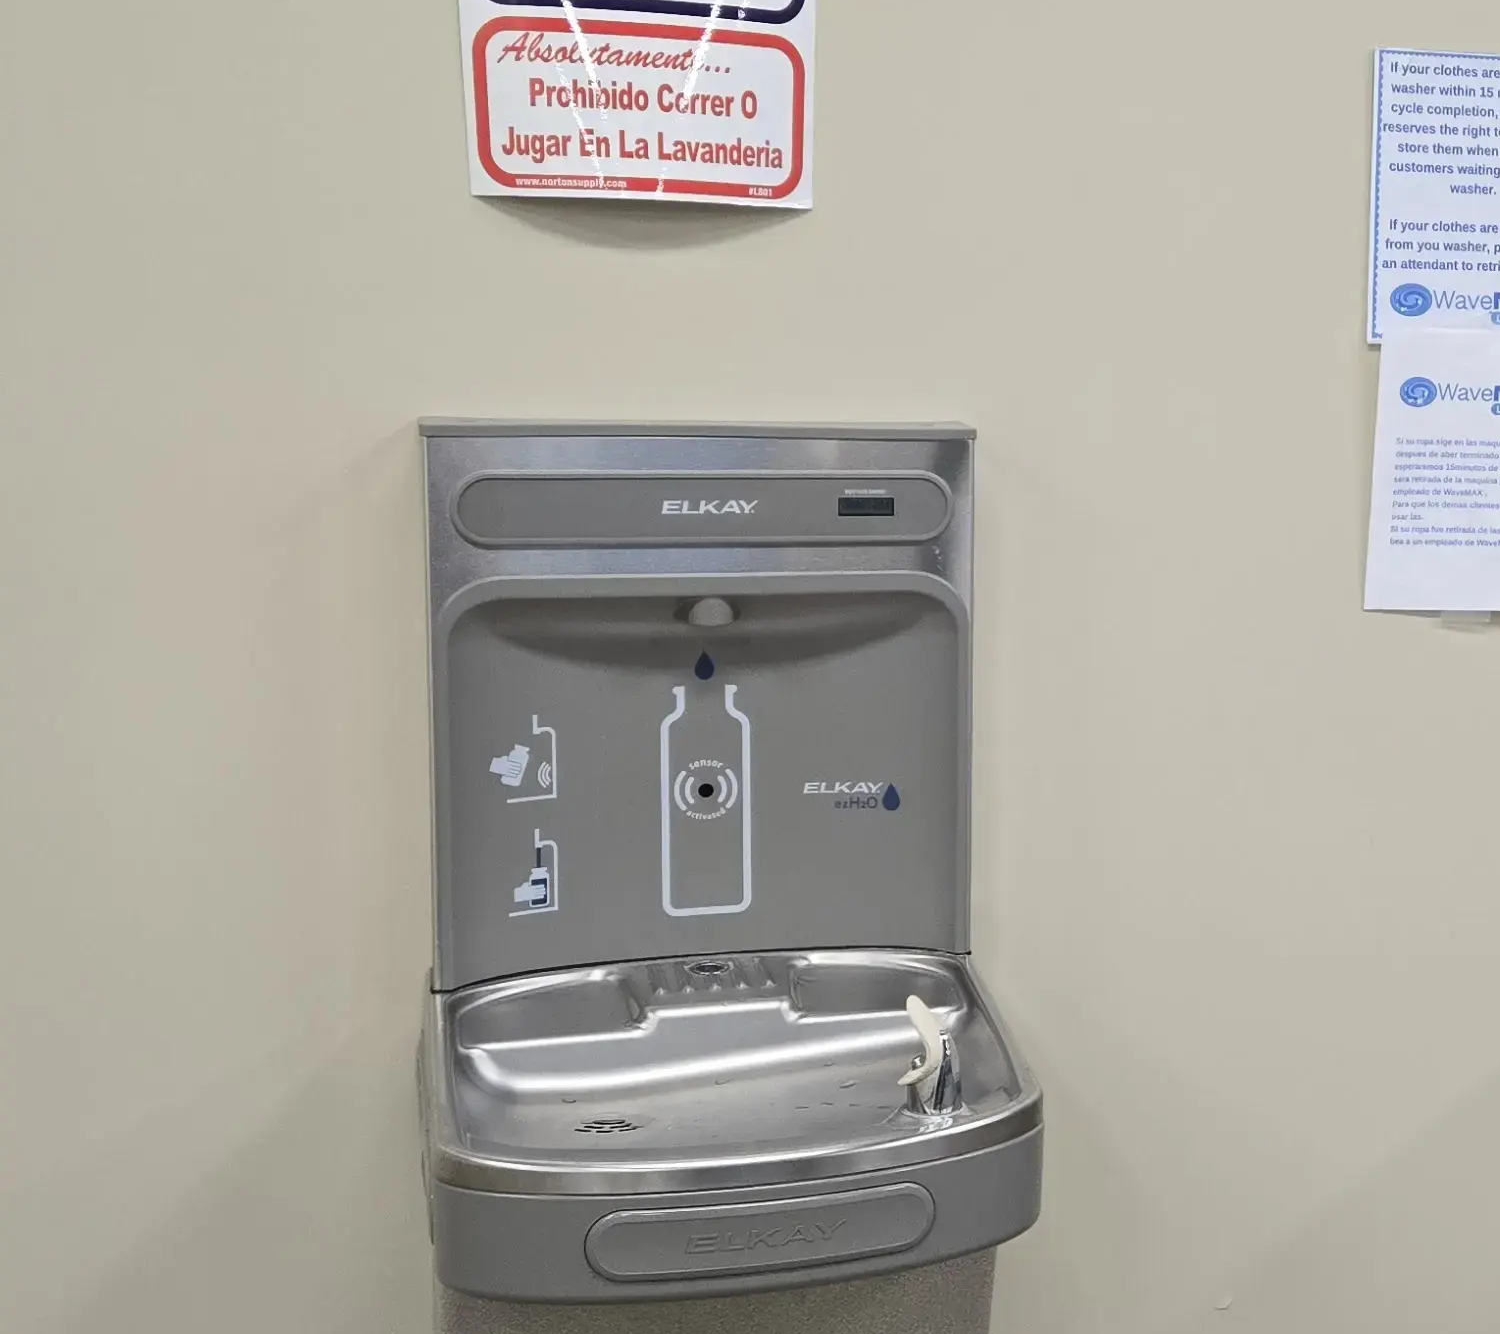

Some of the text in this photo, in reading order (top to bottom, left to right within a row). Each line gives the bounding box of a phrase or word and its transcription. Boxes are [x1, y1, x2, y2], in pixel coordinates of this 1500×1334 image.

[496, 31, 731, 73] Absoltament...
[1390, 62, 1400, 73] If
[1402, 63, 1430, 76] your
[1433, 64, 1478, 78] clothes
[529, 77, 758, 119] Prohibido Correr O
[1391, 83, 1436, 95] washer
[1439, 84, 1476, 98] within
[1480, 87, 1494, 98] 15
[1391, 103, 1424, 116] cycle
[1427, 105, 1498, 120] completion,
[1382, 123, 1436, 135] reserves
[1440, 124, 1459, 136] the
[1462, 125, 1491, 138] right
[502, 126, 783, 169] Jugar En La Lavanderia
[1397, 143, 1429, 154] store
[1432, 144, 1463, 155] them
[1467, 145, 1498, 157] when
[1389, 162, 1454, 174] customers
[1457, 163, 1500, 178] waiting
[516, 177, 626, 189] www.nortonsupply.com
[1450, 183, 1497, 195] washer.
[1389, 219, 1400, 230] If
[1400, 222, 1429, 234] your
[1432, 221, 1476, 233] clothes
[1480, 223, 1498, 234] are
[1385, 239, 1414, 251] from
[1417, 242, 1440, 253] you
[1443, 240, 1491, 254] washer,
[1382, 260, 1397, 270] an
[1400, 258, 1458, 270] attendant
[1461, 260, 1474, 271] to
[1416, 439, 1433, 448] ropa
[661, 500, 759, 514] ELKAY
[688, 760, 724, 770] sensor
[803, 781, 884, 794] ELKAY
[686, 807, 726, 820] activated
[684, 1219, 848, 1255] ELKAY
